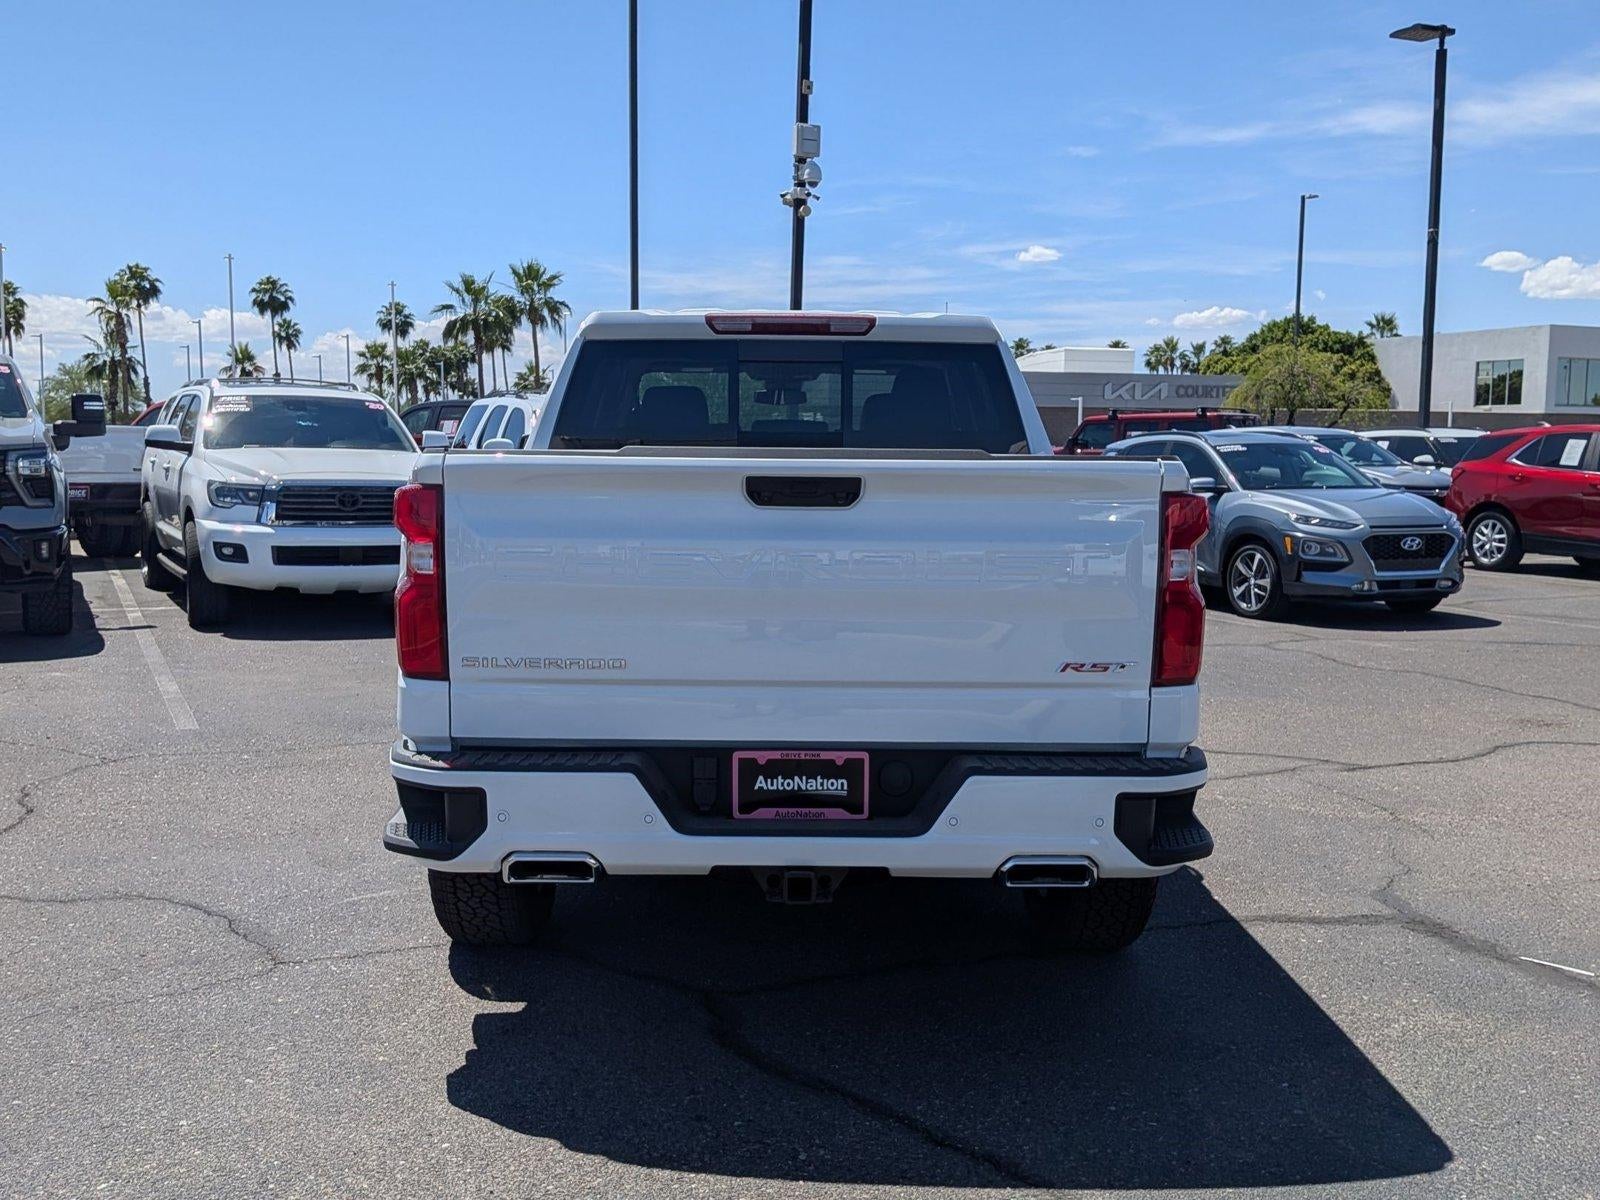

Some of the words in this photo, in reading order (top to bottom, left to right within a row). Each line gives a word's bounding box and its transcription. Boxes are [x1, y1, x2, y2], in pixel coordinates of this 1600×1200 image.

[1104, 381, 1169, 400] KIA
[461, 656, 627, 670] SILVERADO
[1057, 661, 1138, 673] RST
[754, 775, 848, 790] AutoNation
[774, 809, 826, 818] AutoNation
